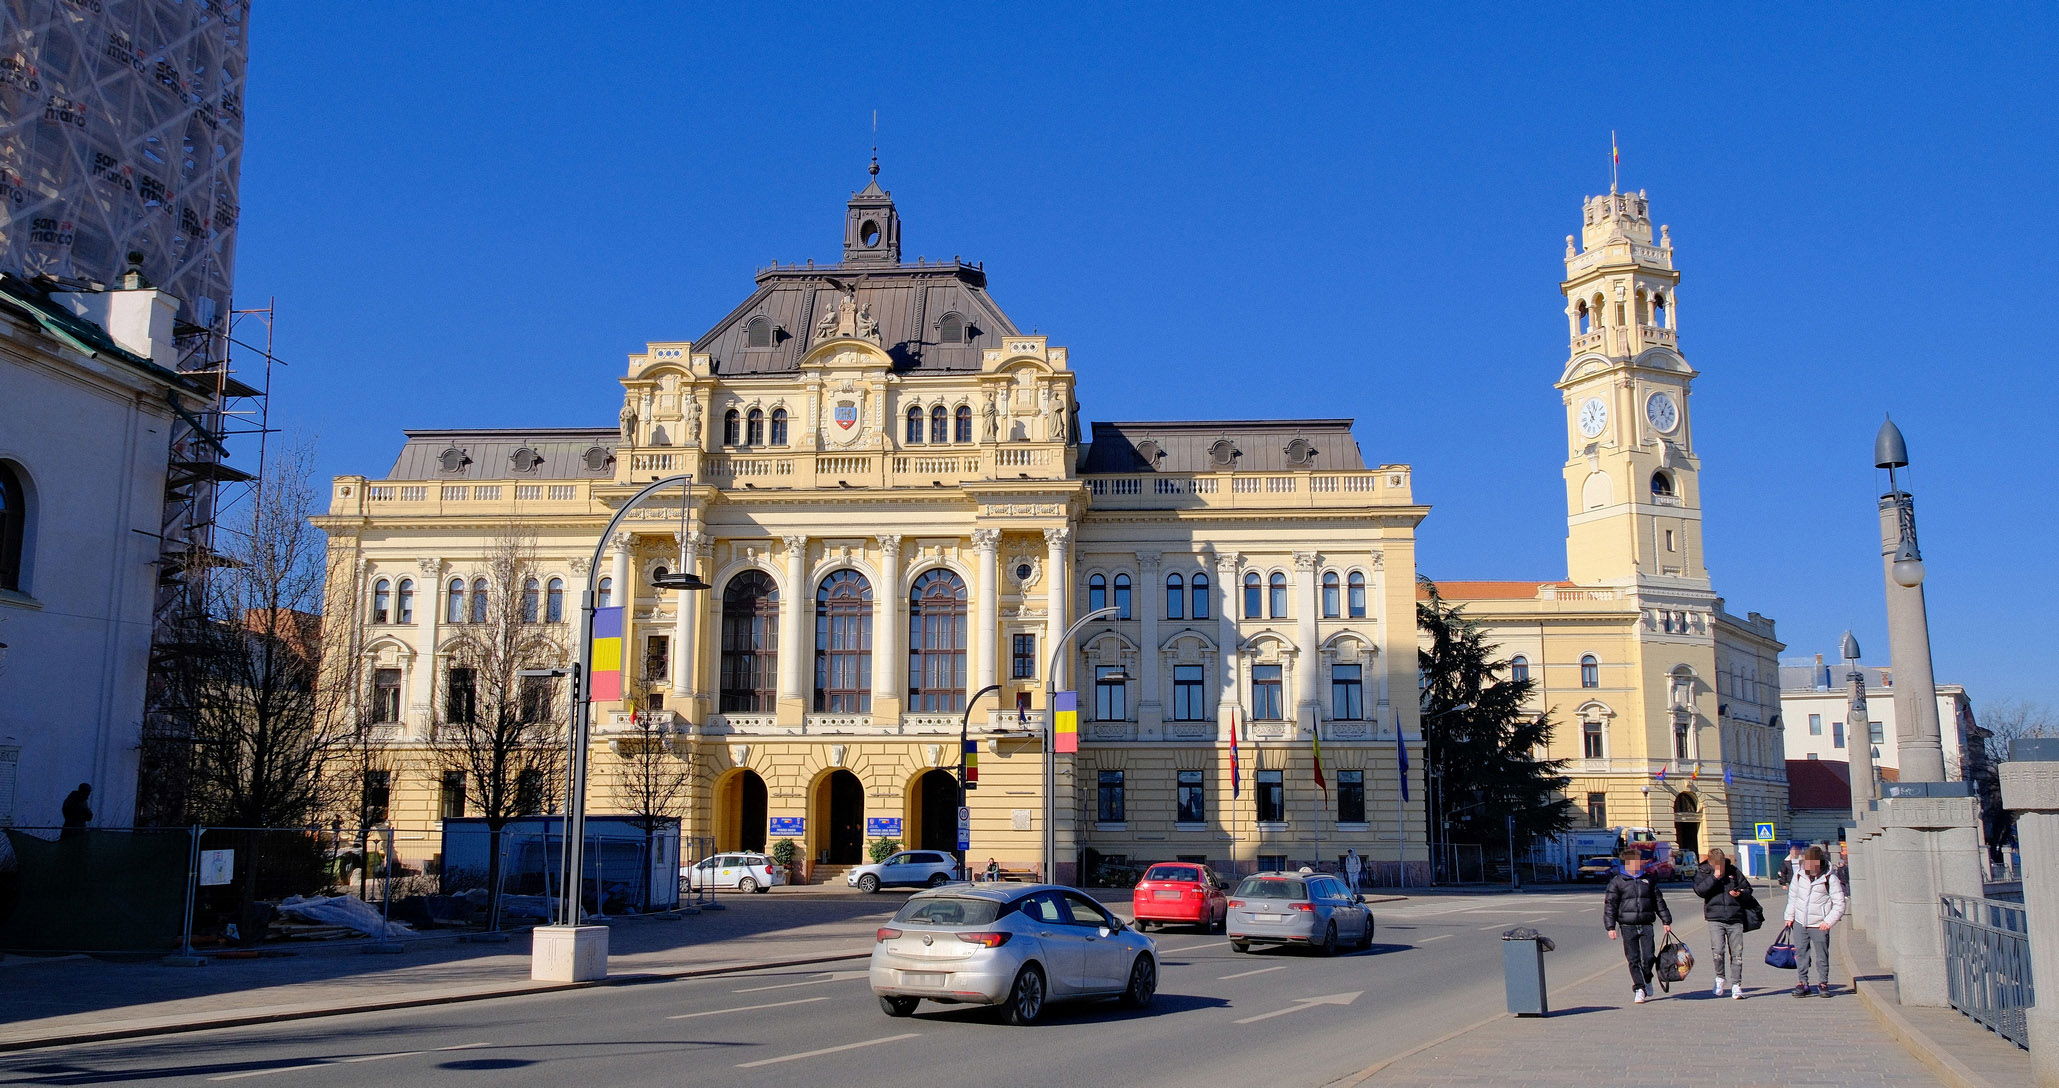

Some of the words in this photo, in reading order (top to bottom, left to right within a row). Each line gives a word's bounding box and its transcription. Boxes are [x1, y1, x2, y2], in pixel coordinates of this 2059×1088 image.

[110, 33, 132, 52] san
[107, 45, 146, 73] marco
[95, 152, 119, 169] san
[93, 164, 132, 190] marco
[142, 175, 166, 195] san
[33, 217, 58, 230] san
[31, 230, 73, 245] marco
